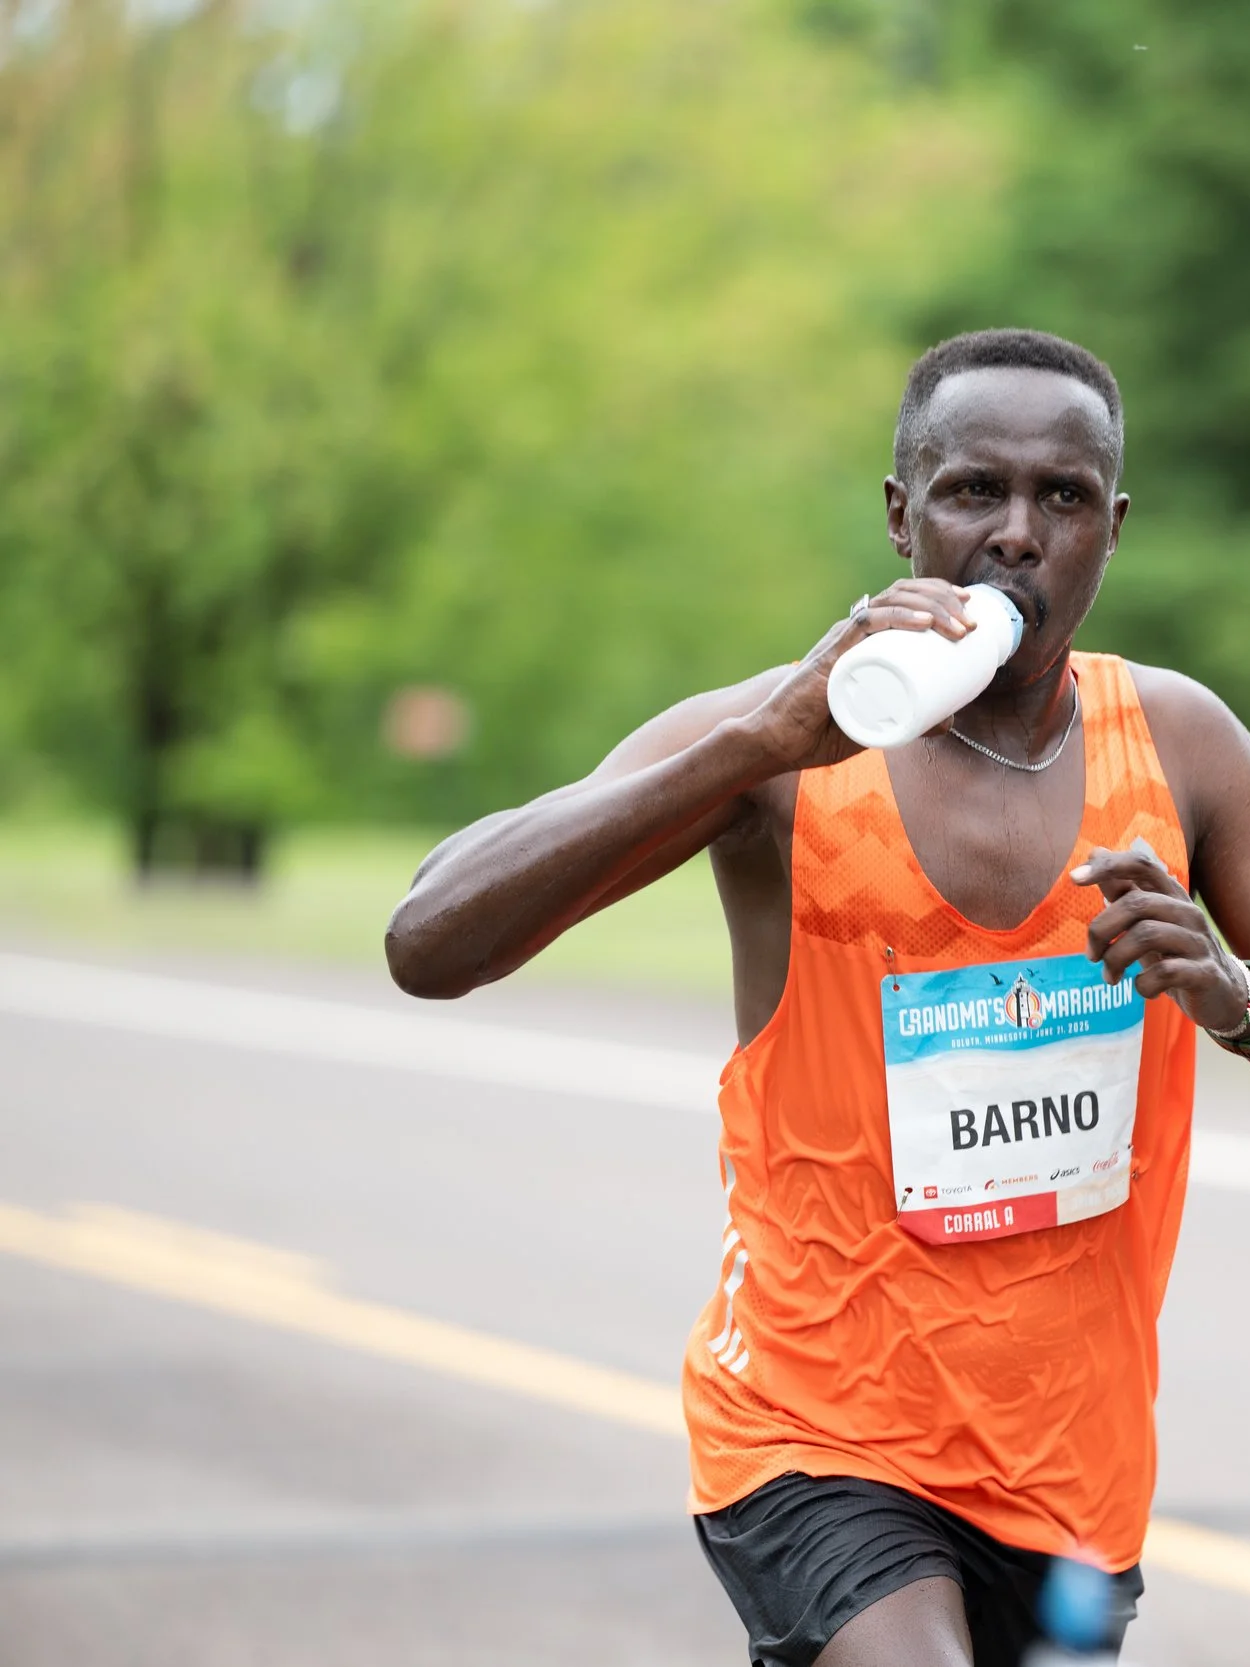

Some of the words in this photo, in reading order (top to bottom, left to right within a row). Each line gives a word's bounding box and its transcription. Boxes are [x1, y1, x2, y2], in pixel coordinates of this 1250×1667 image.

[899, 997, 1006, 1036] GRANDMA'S
[1040, 977, 1133, 1020] MARATHON
[1067, 1020, 1090, 1034] 2025
[950, 1090, 1100, 1151] BARNO
[941, 1185, 973, 1196] TOYOTA
[1001, 1174, 1039, 1186] MEMBERS
[944, 1207, 1000, 1234] CORRAL
[1004, 1206, 1015, 1227] A
